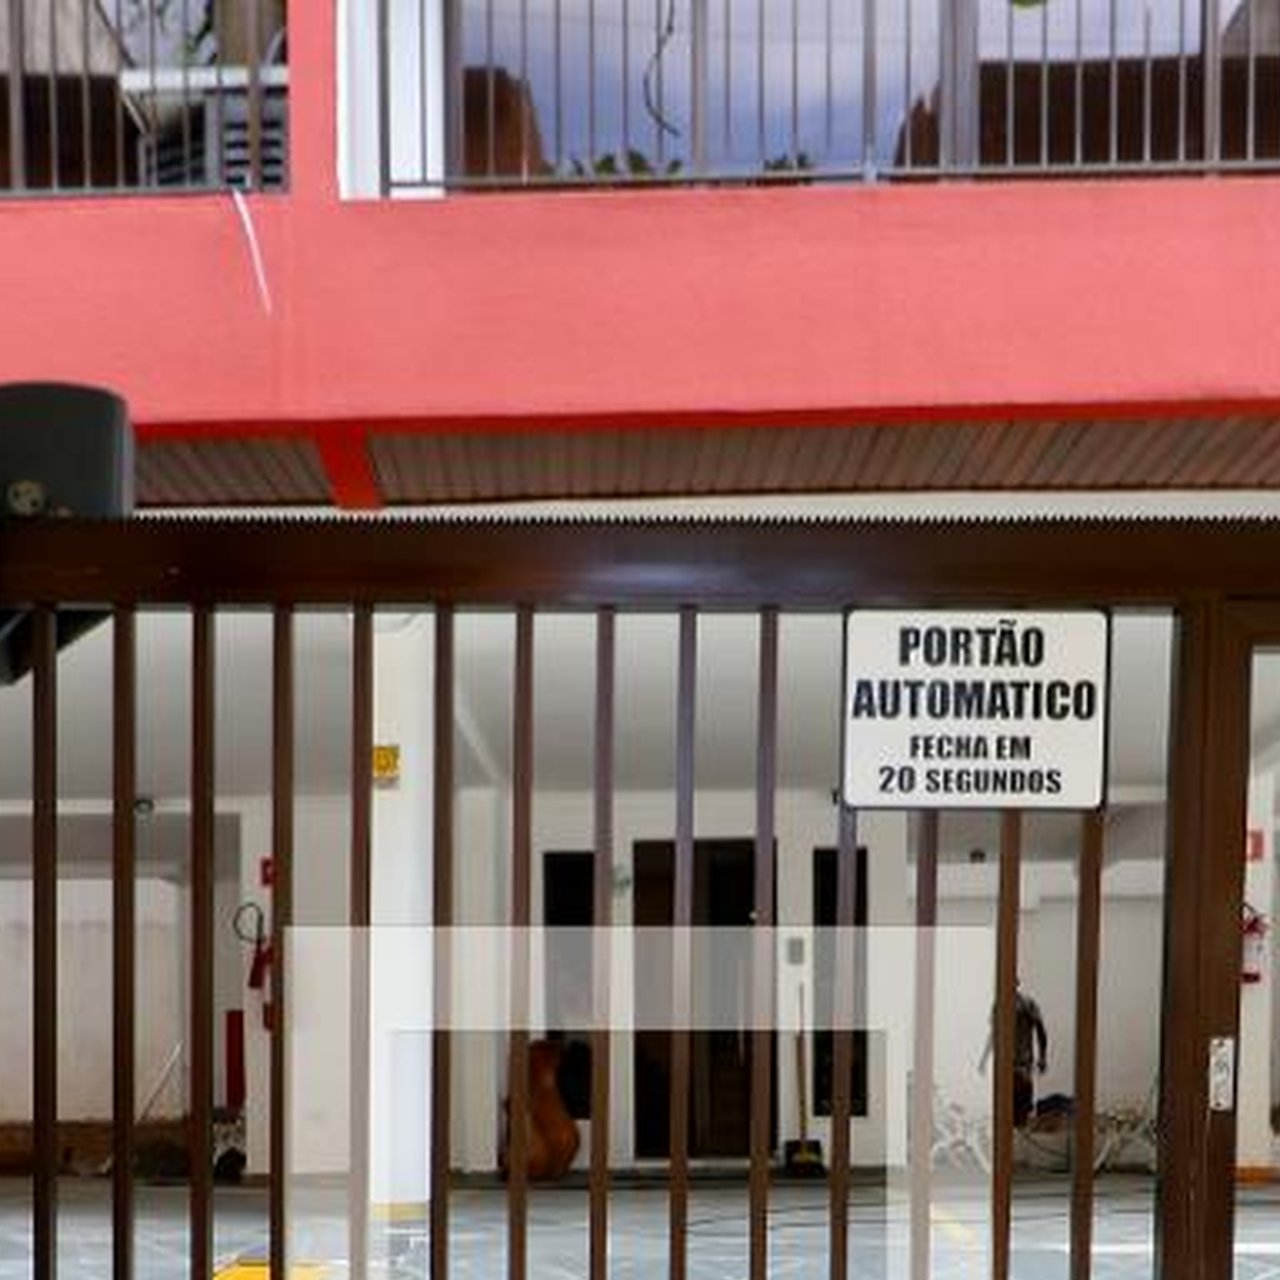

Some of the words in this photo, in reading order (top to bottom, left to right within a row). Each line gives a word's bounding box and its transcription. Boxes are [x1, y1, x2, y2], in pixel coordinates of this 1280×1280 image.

[899, 618, 1045, 667] PORTÃO
[852, 679, 1097, 720] AUTOMATICO
[910, 735, 989, 759] FECHA
[996, 735, 1032, 760] EM
[879, 766, 916, 793] 20
[925, 769, 1063, 794] SEGUNDOS
